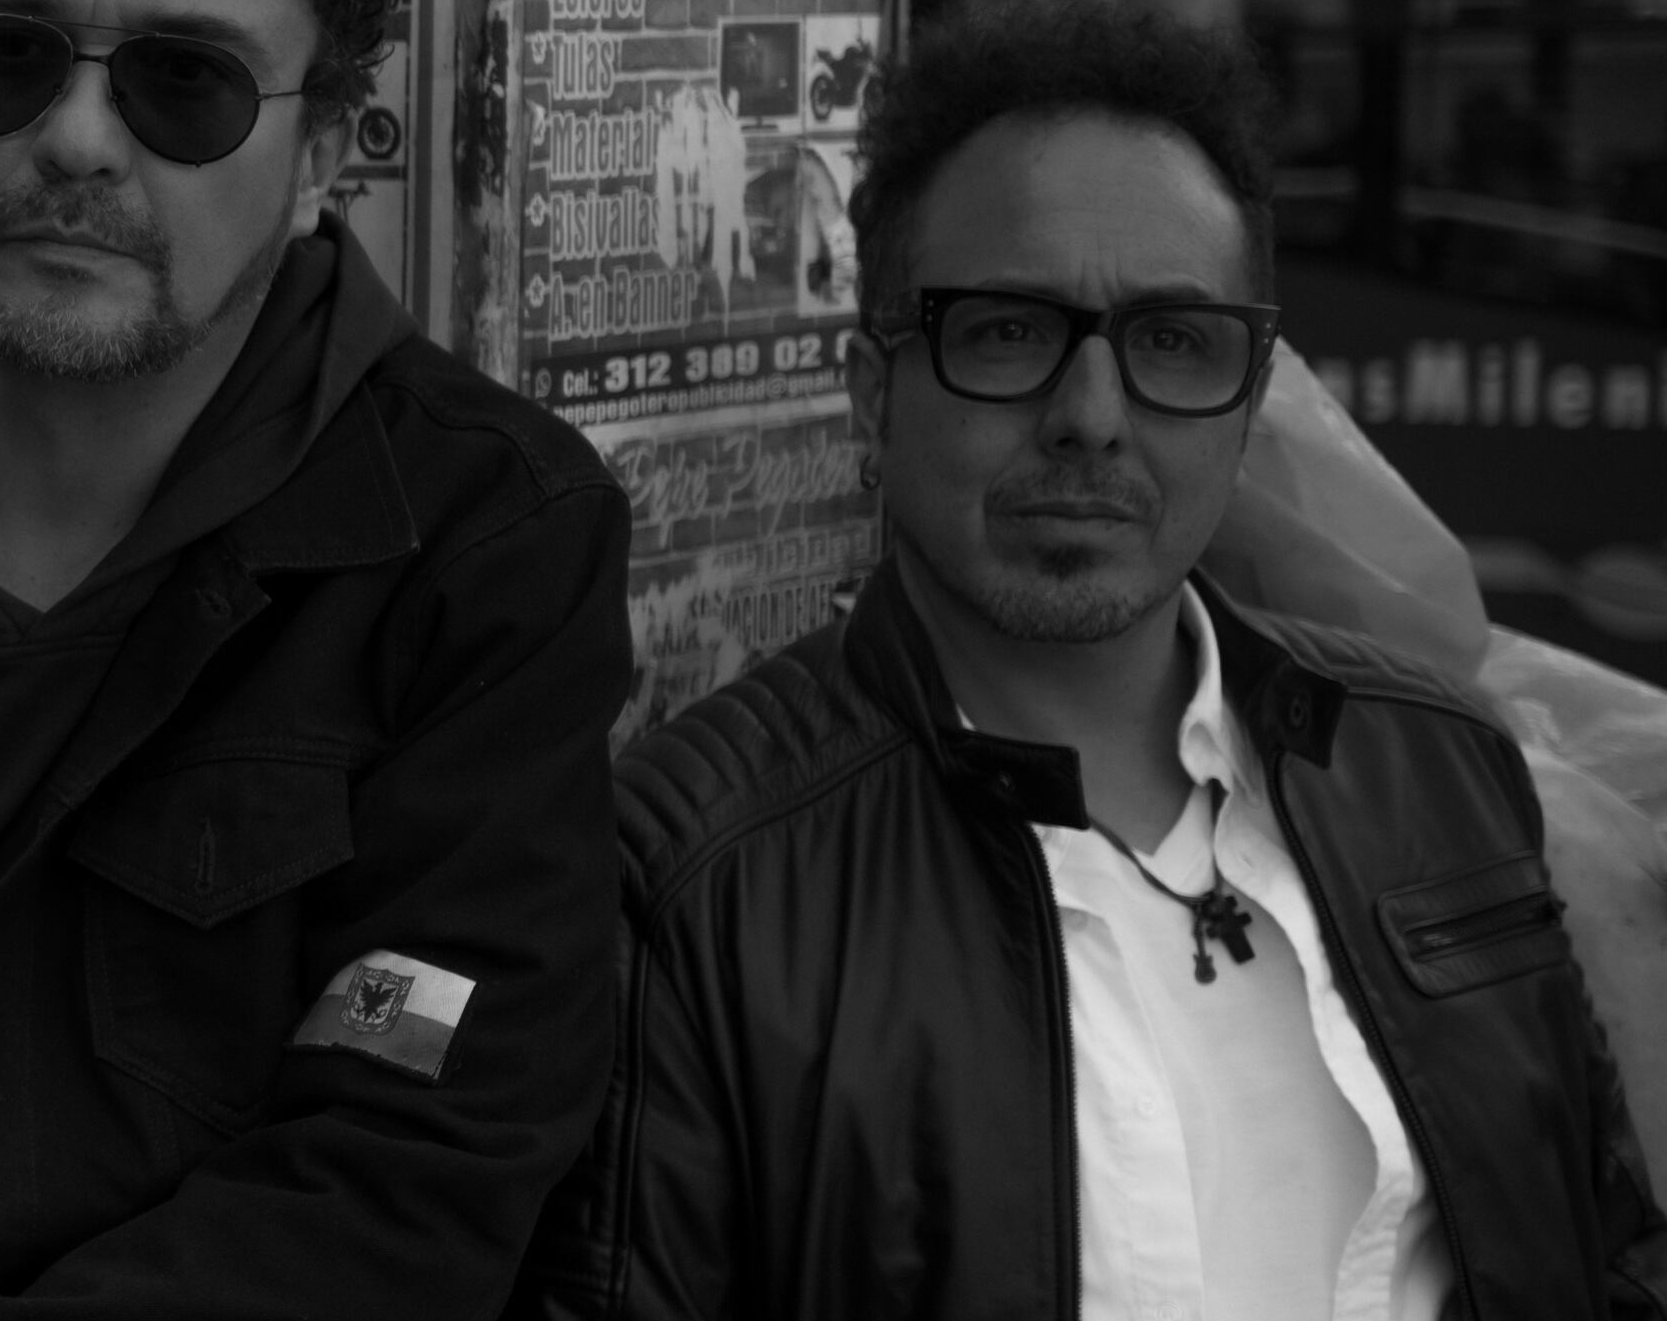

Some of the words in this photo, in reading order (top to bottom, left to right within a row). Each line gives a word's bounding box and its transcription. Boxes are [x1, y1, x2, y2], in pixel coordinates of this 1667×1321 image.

[552, 31, 614, 100] Tulas
[551, 108, 655, 180] Material
[613, 265, 700, 333] Banner
[604, 352, 671, 393] 312
[774, 334, 822, 372] 02
